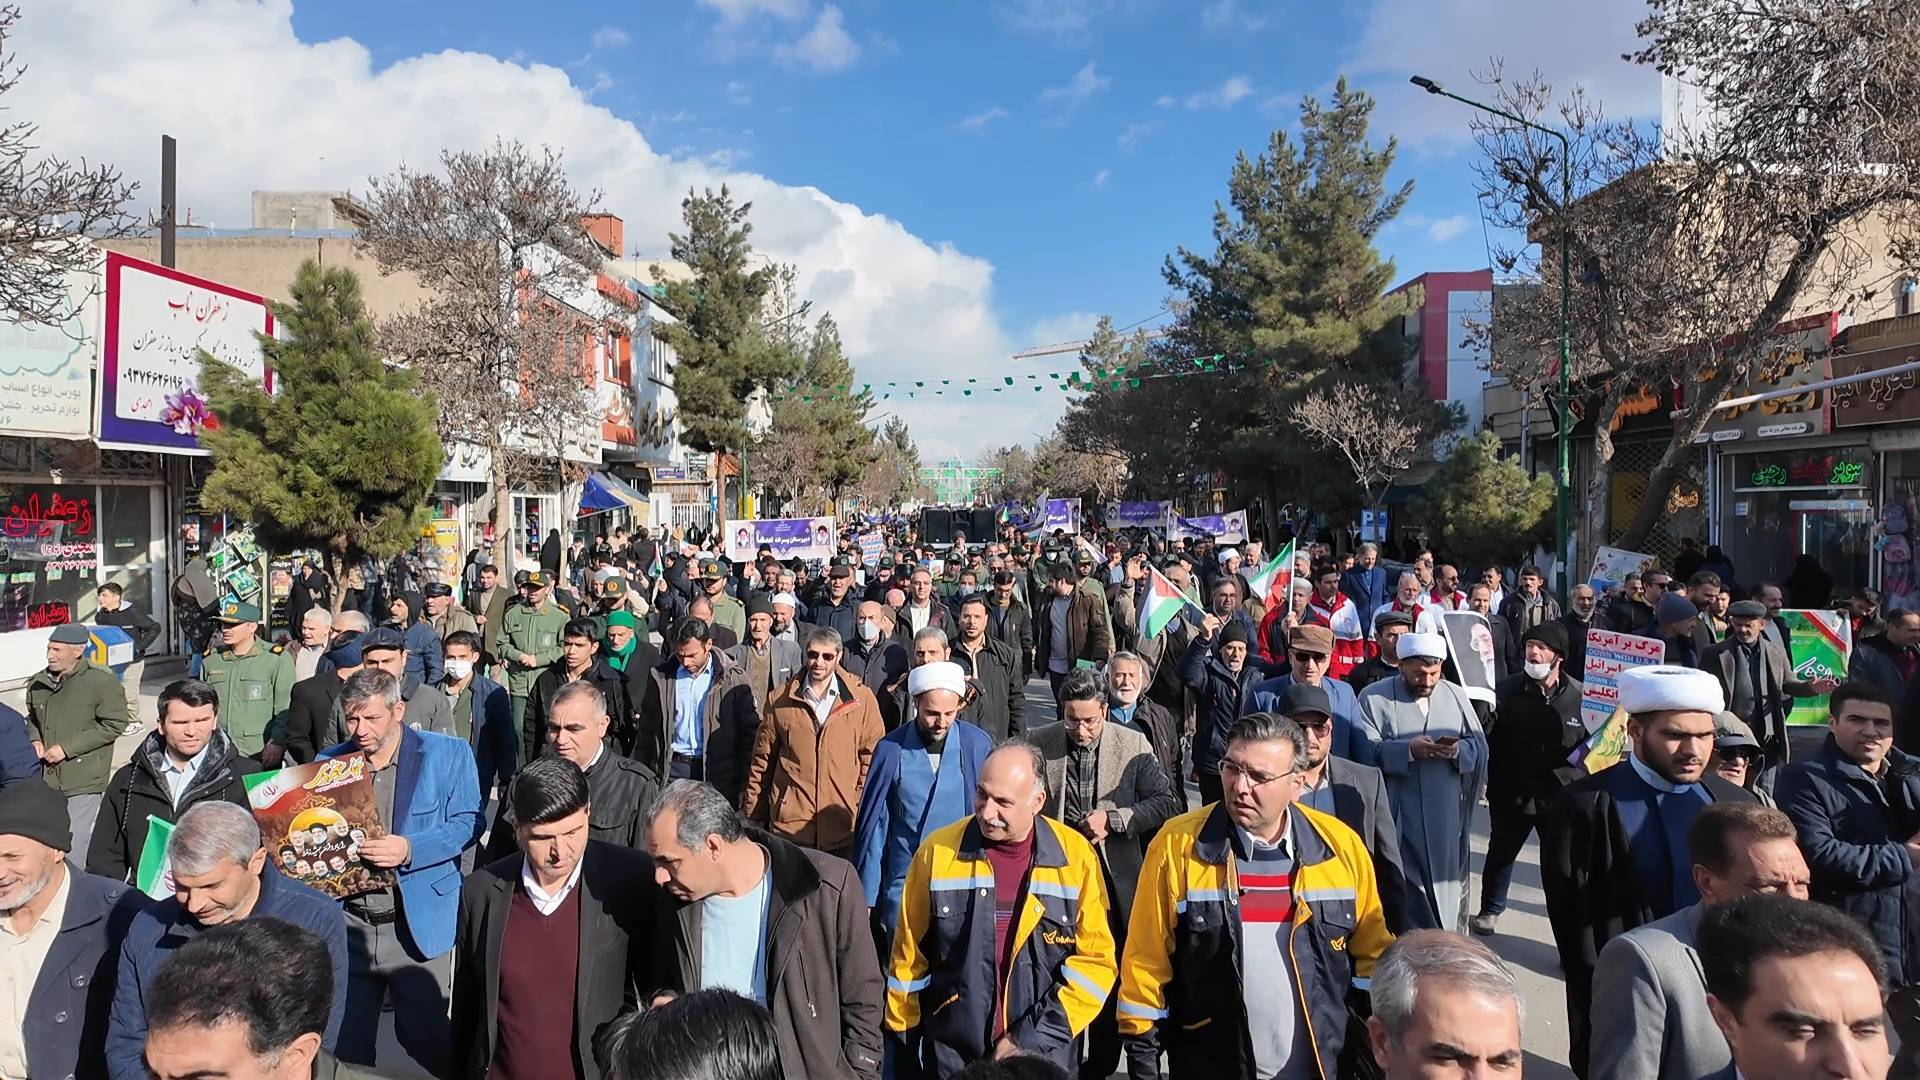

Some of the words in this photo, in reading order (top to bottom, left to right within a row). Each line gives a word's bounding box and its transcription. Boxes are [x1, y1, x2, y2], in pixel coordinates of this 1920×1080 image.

[168, 290, 191, 320] ناب
[195, 295, 230, 323] زعفران
[133, 329, 165, 353] زعفران
[123, 367, 183, 390] ۰۹۳۷۴۶۲۶۱۹۶
[31, 384, 53, 397] انواع
[1751, 464, 1787, 486] رجبی
[1831, 461, 1864, 484] سوپر
[5, 492, 92, 538] زعفران
[28, 602, 69, 628] زعفران
[1588, 632, 1621, 647] آمریکا
[1621, 641, 1632, 651] بر
[1635, 640, 1661, 655] مرگ
[1588, 648, 1612, 657] DOWN
[1613, 652, 1634, 662] WITH
[1585, 658, 1622, 674] اسرائیل
[1585, 675, 1608, 685] DOWN
[1583, 687, 1619, 700] انگلیس
[1582, 701, 1602, 711] DOWN
